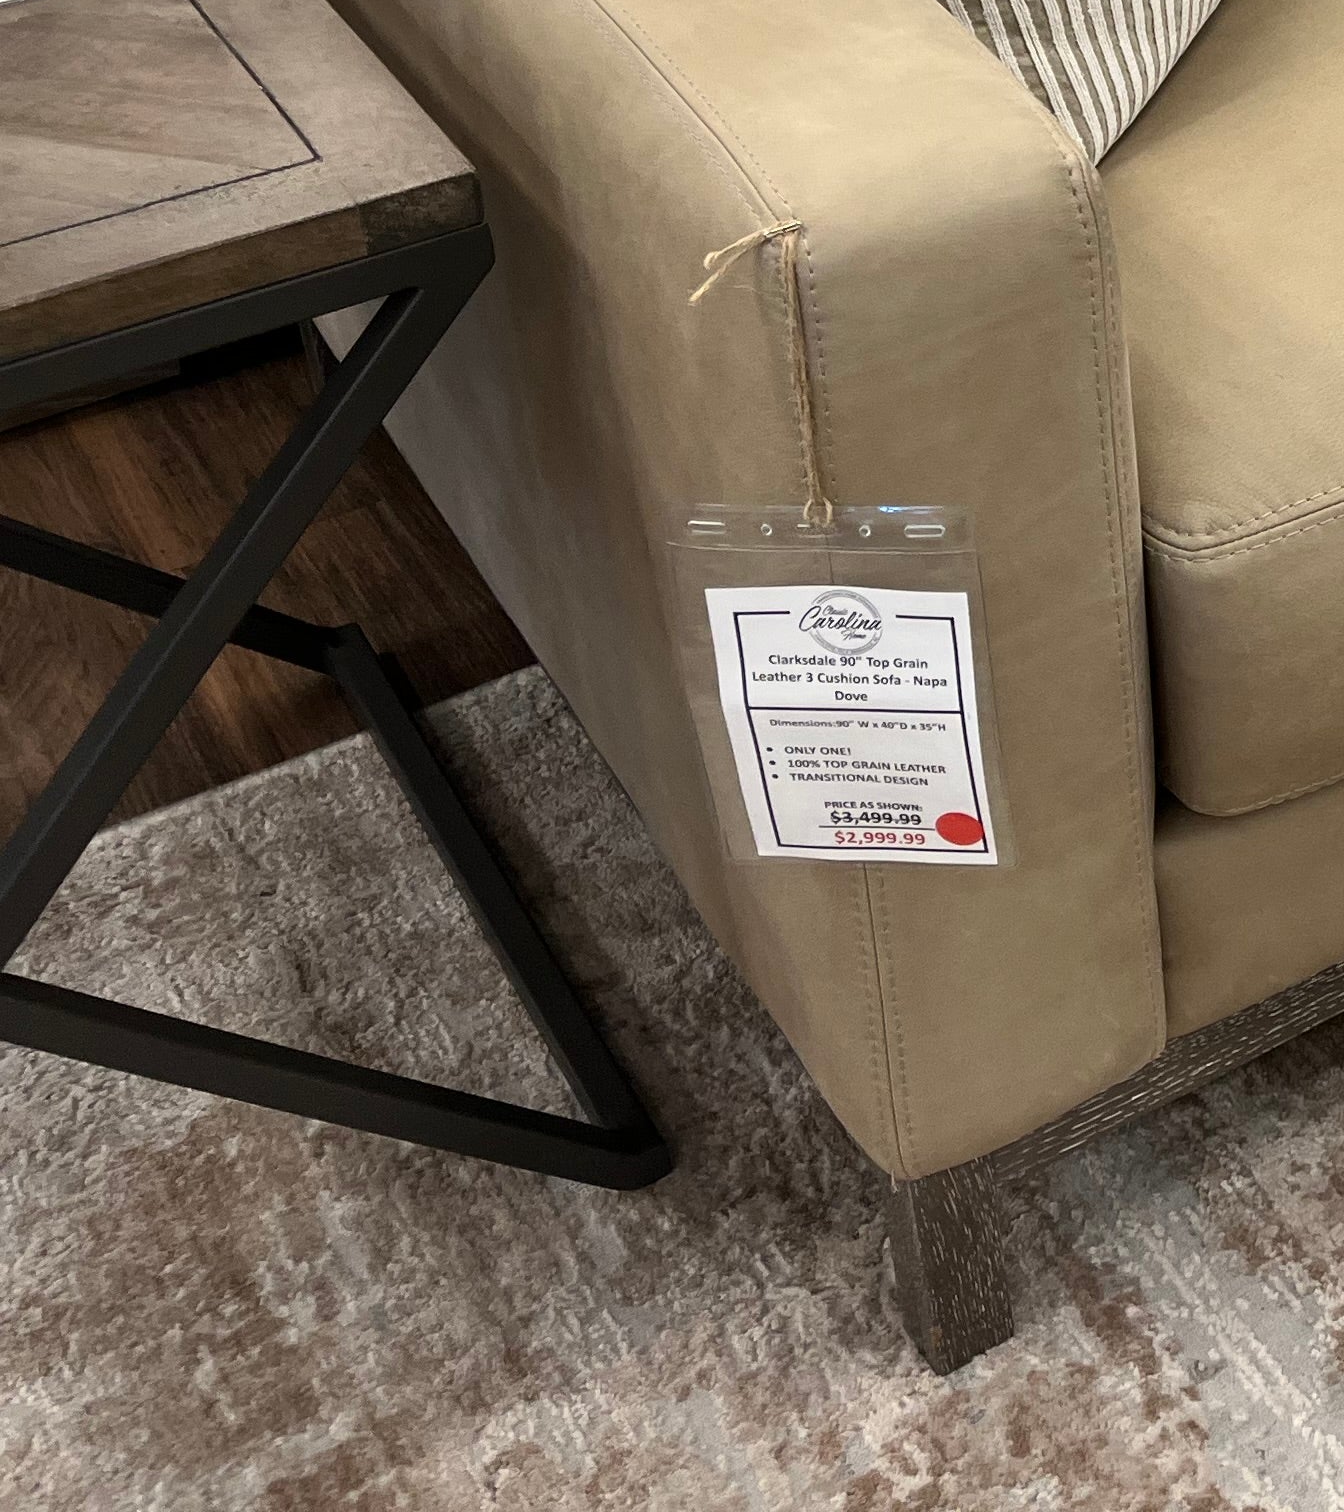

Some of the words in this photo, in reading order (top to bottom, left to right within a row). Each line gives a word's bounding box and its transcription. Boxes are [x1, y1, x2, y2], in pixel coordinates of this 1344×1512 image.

[798, 605, 882, 632] Carolina
[768, 654, 836, 666] Clarksdale
[840, 656, 861, 667] 90"
[866, 656, 890, 670] Top
[893, 657, 928, 669] Grain
[752, 671, 802, 682] Leather
[806, 672, 813, 683] 3
[817, 672, 869, 684] Cushion
[873, 674, 901, 685] Sofa
[913, 676, 947, 688] Napa
[834, 690, 868, 701] Dove
[857, 720, 869, 728] W
[784, 746, 816, 755] ONLY
[820, 746, 851, 755] ONE!
[788, 759, 820, 768] 100%
[822, 760, 848, 768] TOP
[851, 760, 891, 770] GRAIN
[894, 762, 946, 773] LEATHER
[789, 773, 881, 783] TRANSITIONAL
[884, 775, 929, 786] DESIGN
[876, 802, 923, 812] SHOWN:
[830, 810, 922, 825] $3,499.99
[834, 830, 925, 845] $2,999.99
